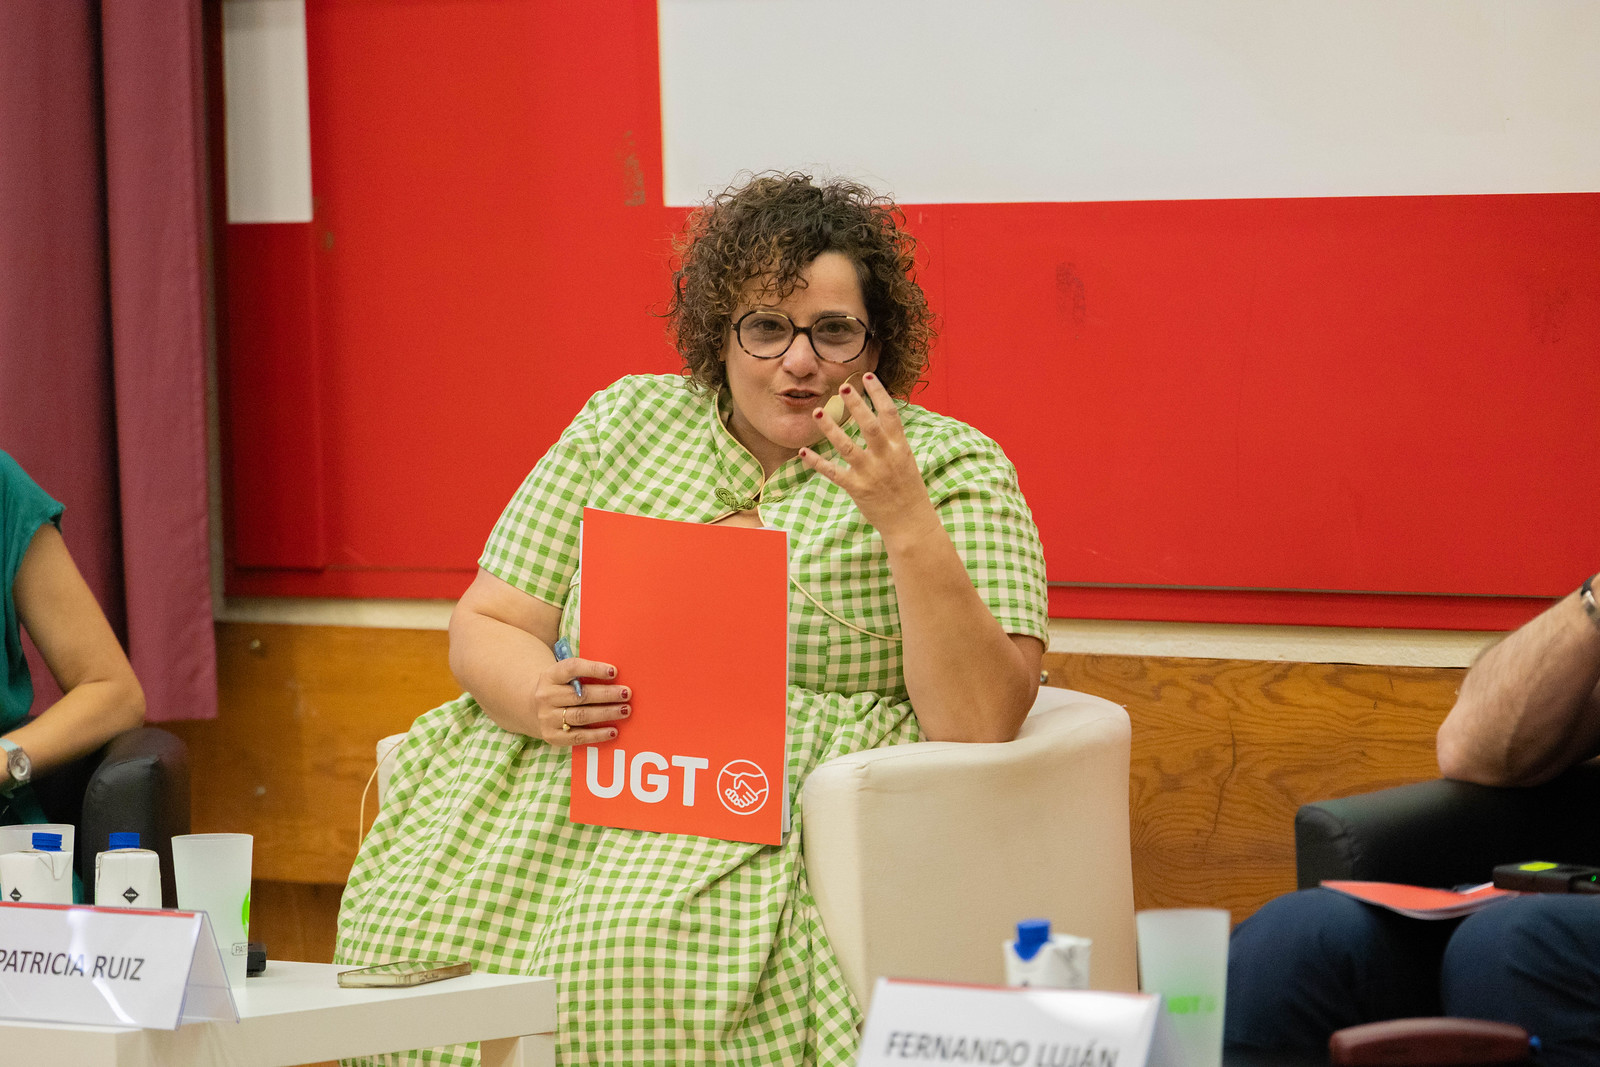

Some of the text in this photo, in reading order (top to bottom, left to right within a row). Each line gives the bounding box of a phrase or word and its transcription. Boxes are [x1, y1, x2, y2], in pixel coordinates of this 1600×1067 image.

[586, 746, 709, 807] UGT
[92, 955, 145, 981] RUIZ
[885, 1031, 1120, 1067] FERNANDO LUJÁN
